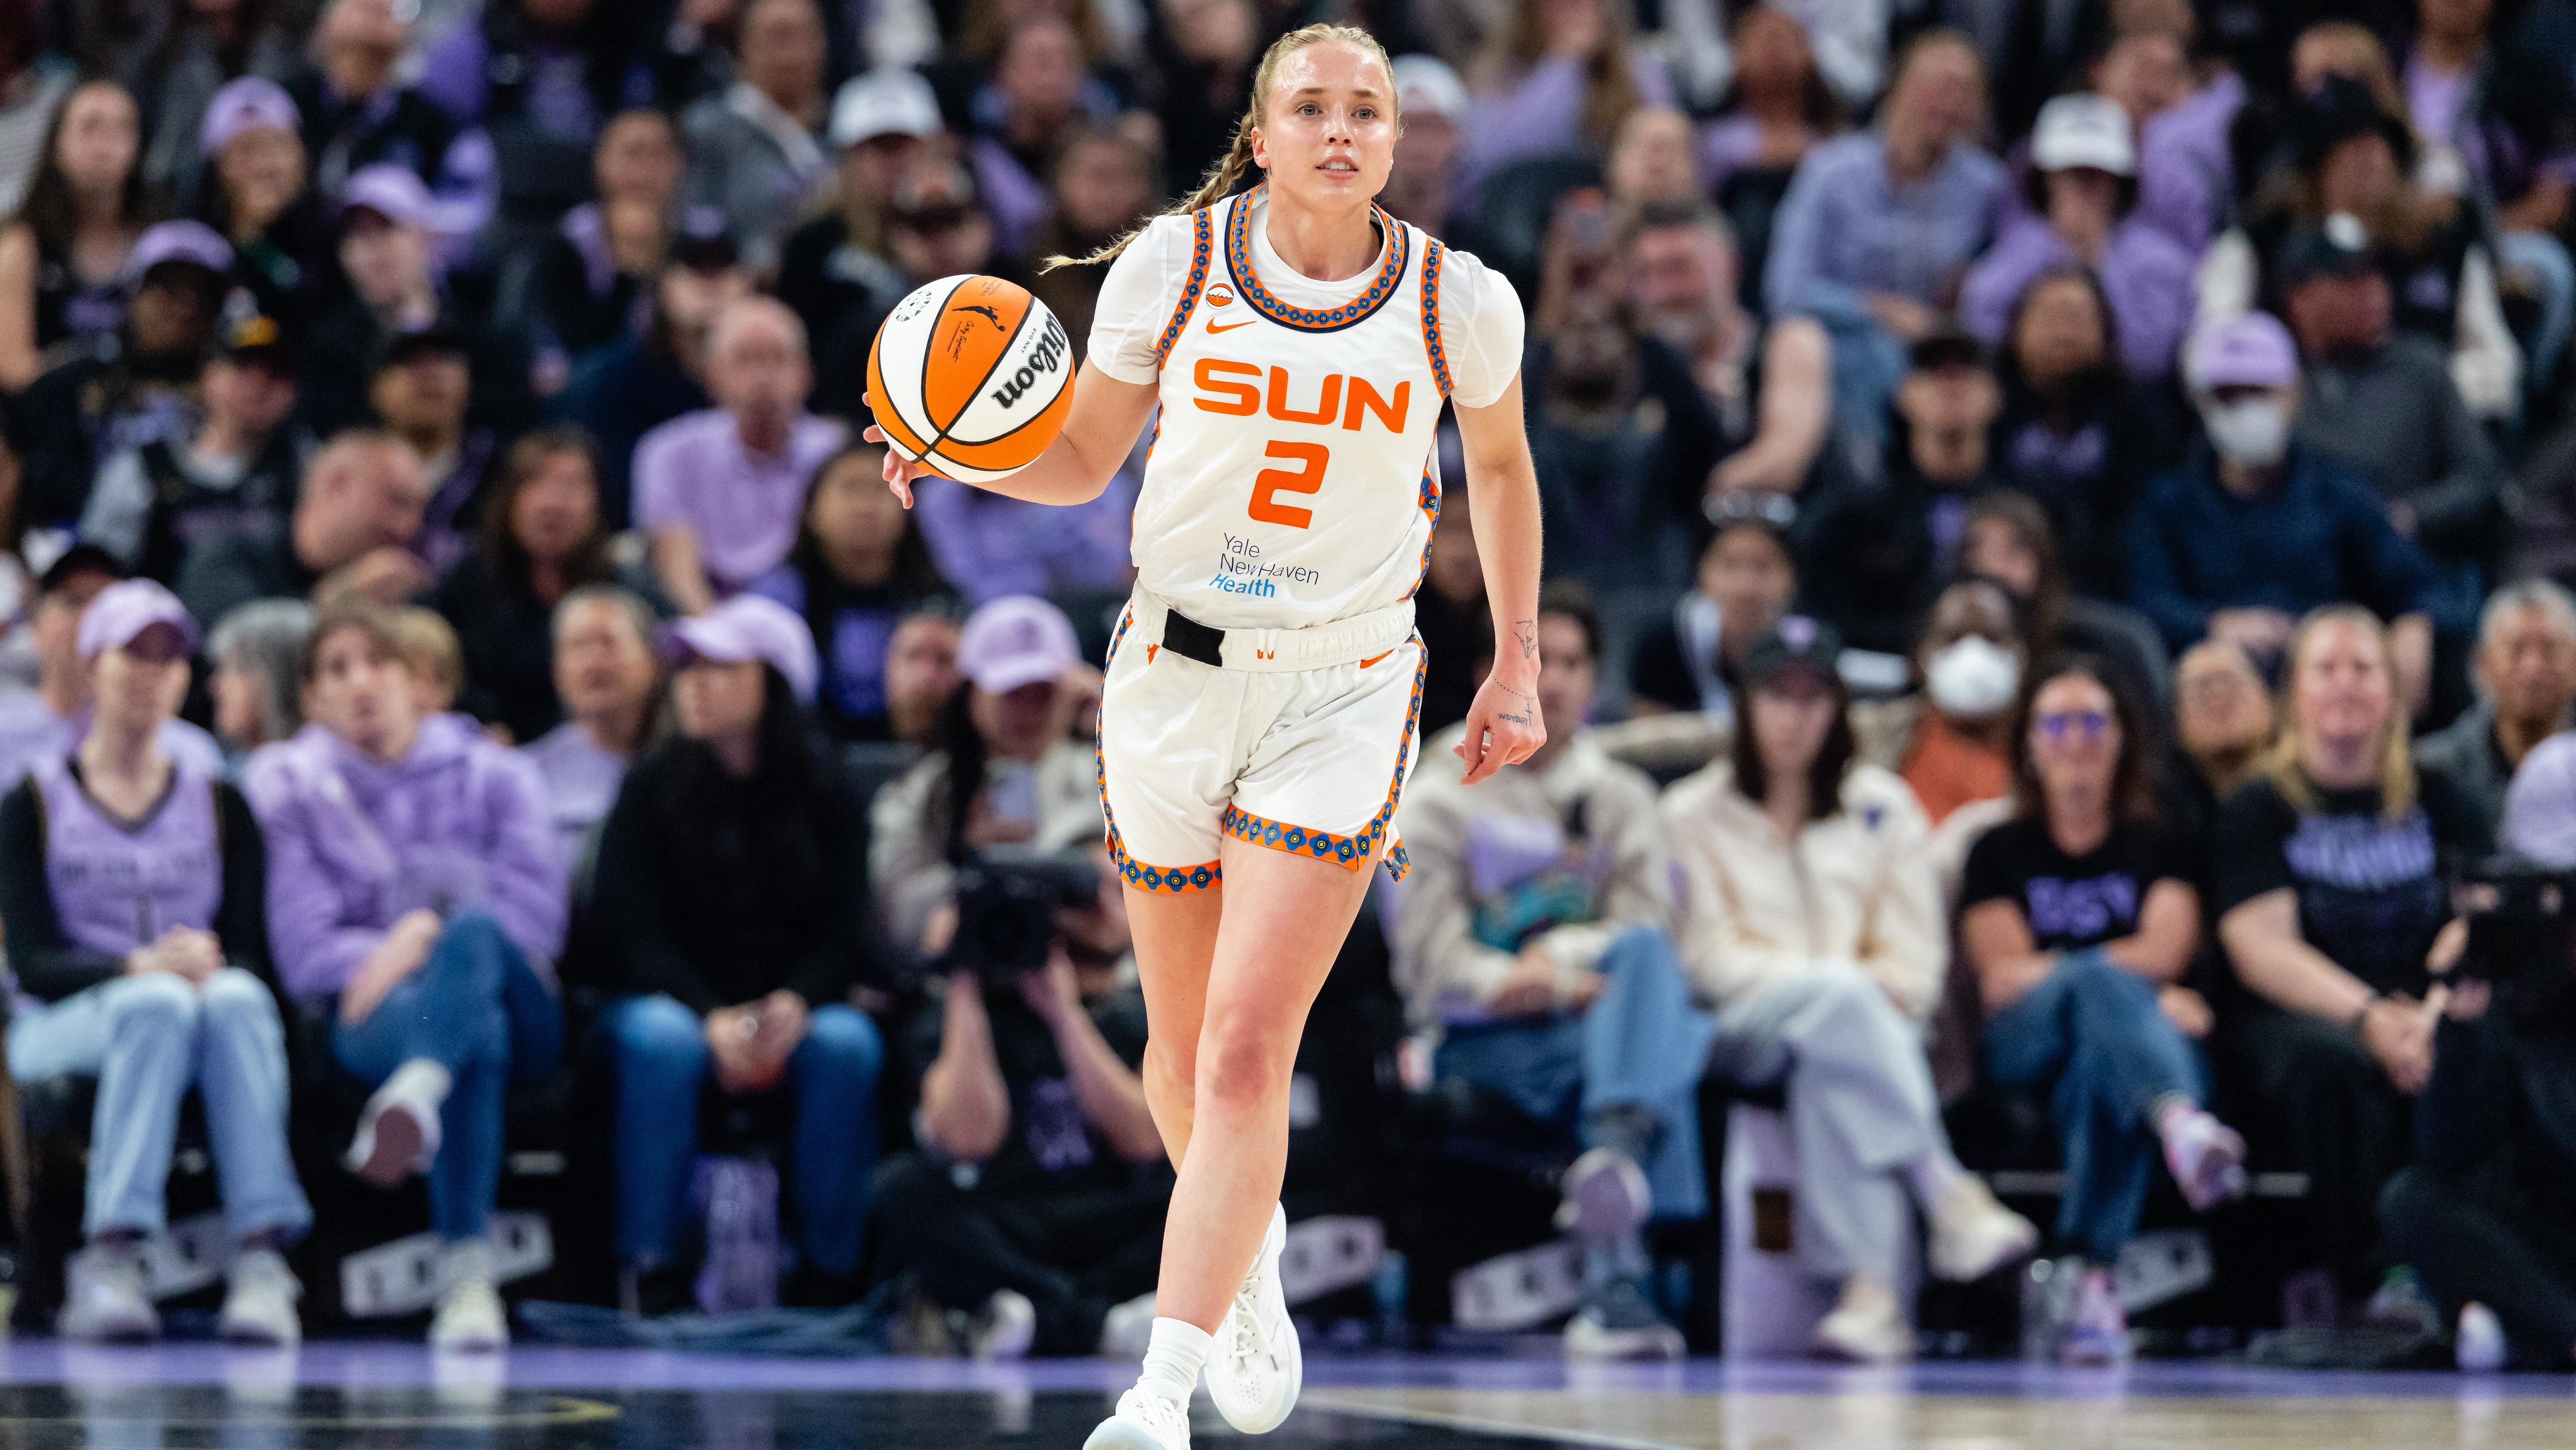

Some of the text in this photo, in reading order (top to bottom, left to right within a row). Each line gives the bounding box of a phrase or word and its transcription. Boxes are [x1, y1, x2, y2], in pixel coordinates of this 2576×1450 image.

[990, 311, 1066, 410] Wilson
[1021, 341, 1030, 353] NXT
[1193, 358, 1410, 434] SUN
[1248, 440, 1330, 529] 2
[1224, 532, 1260, 558] Yale
[1209, 573, 1276, 598] Health
